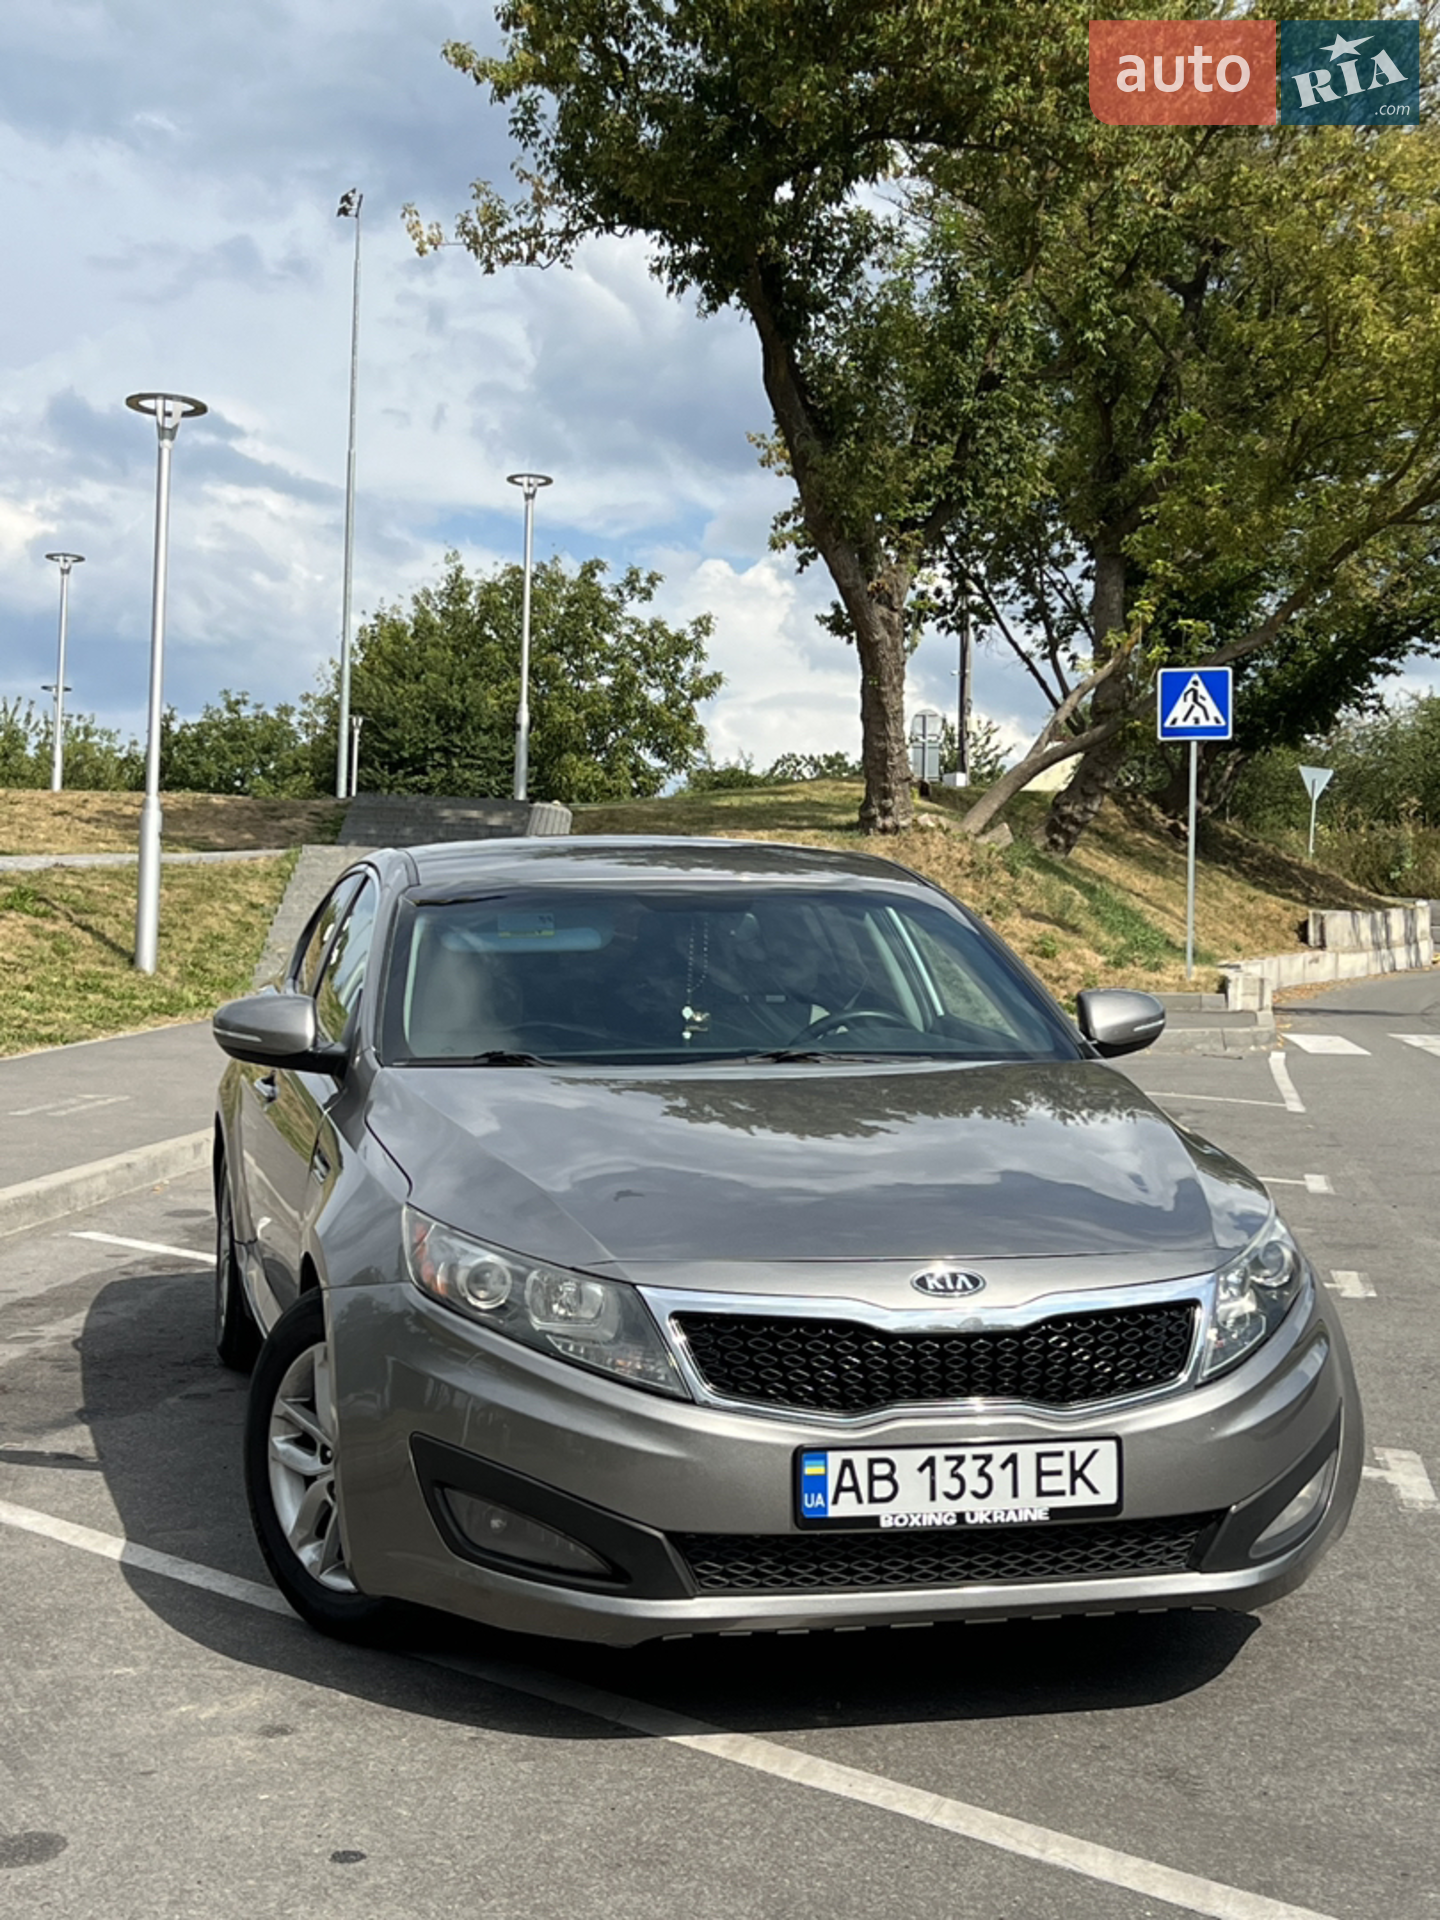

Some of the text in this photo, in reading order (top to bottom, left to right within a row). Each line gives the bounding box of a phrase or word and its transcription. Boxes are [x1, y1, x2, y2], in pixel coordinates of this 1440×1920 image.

[924, 1273, 974, 1290] KIA
[831, 1448, 1101, 1505] AB 1331 EK
[804, 1493, 825, 1508] UA
[879, 1507, 1050, 1528] BOXING UKRAINE
